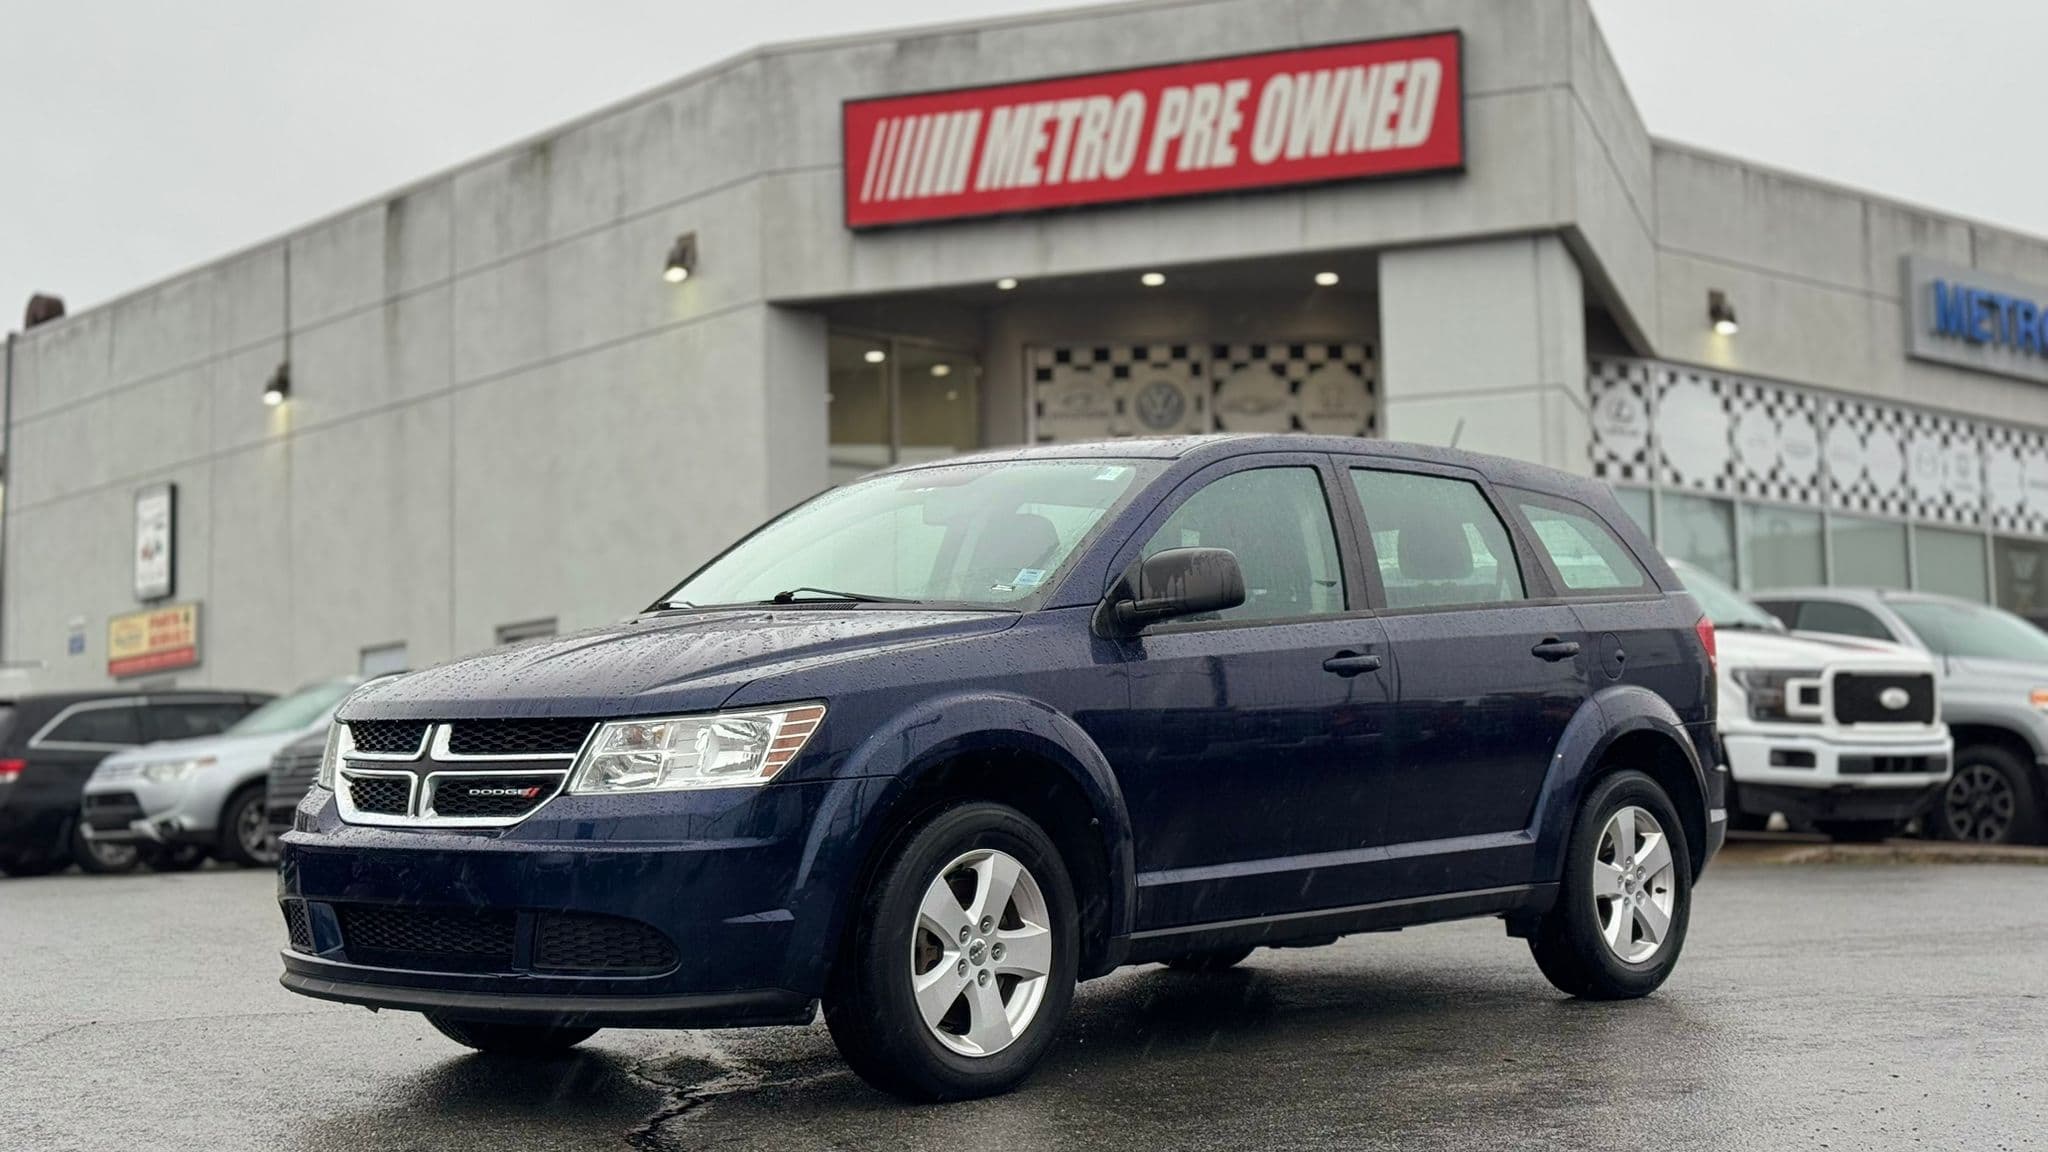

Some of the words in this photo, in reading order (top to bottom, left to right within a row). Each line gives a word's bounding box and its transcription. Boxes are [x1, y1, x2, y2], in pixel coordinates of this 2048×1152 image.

[975, 90, 1147, 192] METRO
[1145, 78, 1252, 175] PRE
[1249, 57, 1443, 165] OWNED
[1933, 276, 2048, 358] METR
[469, 788, 528, 796] DODGE
